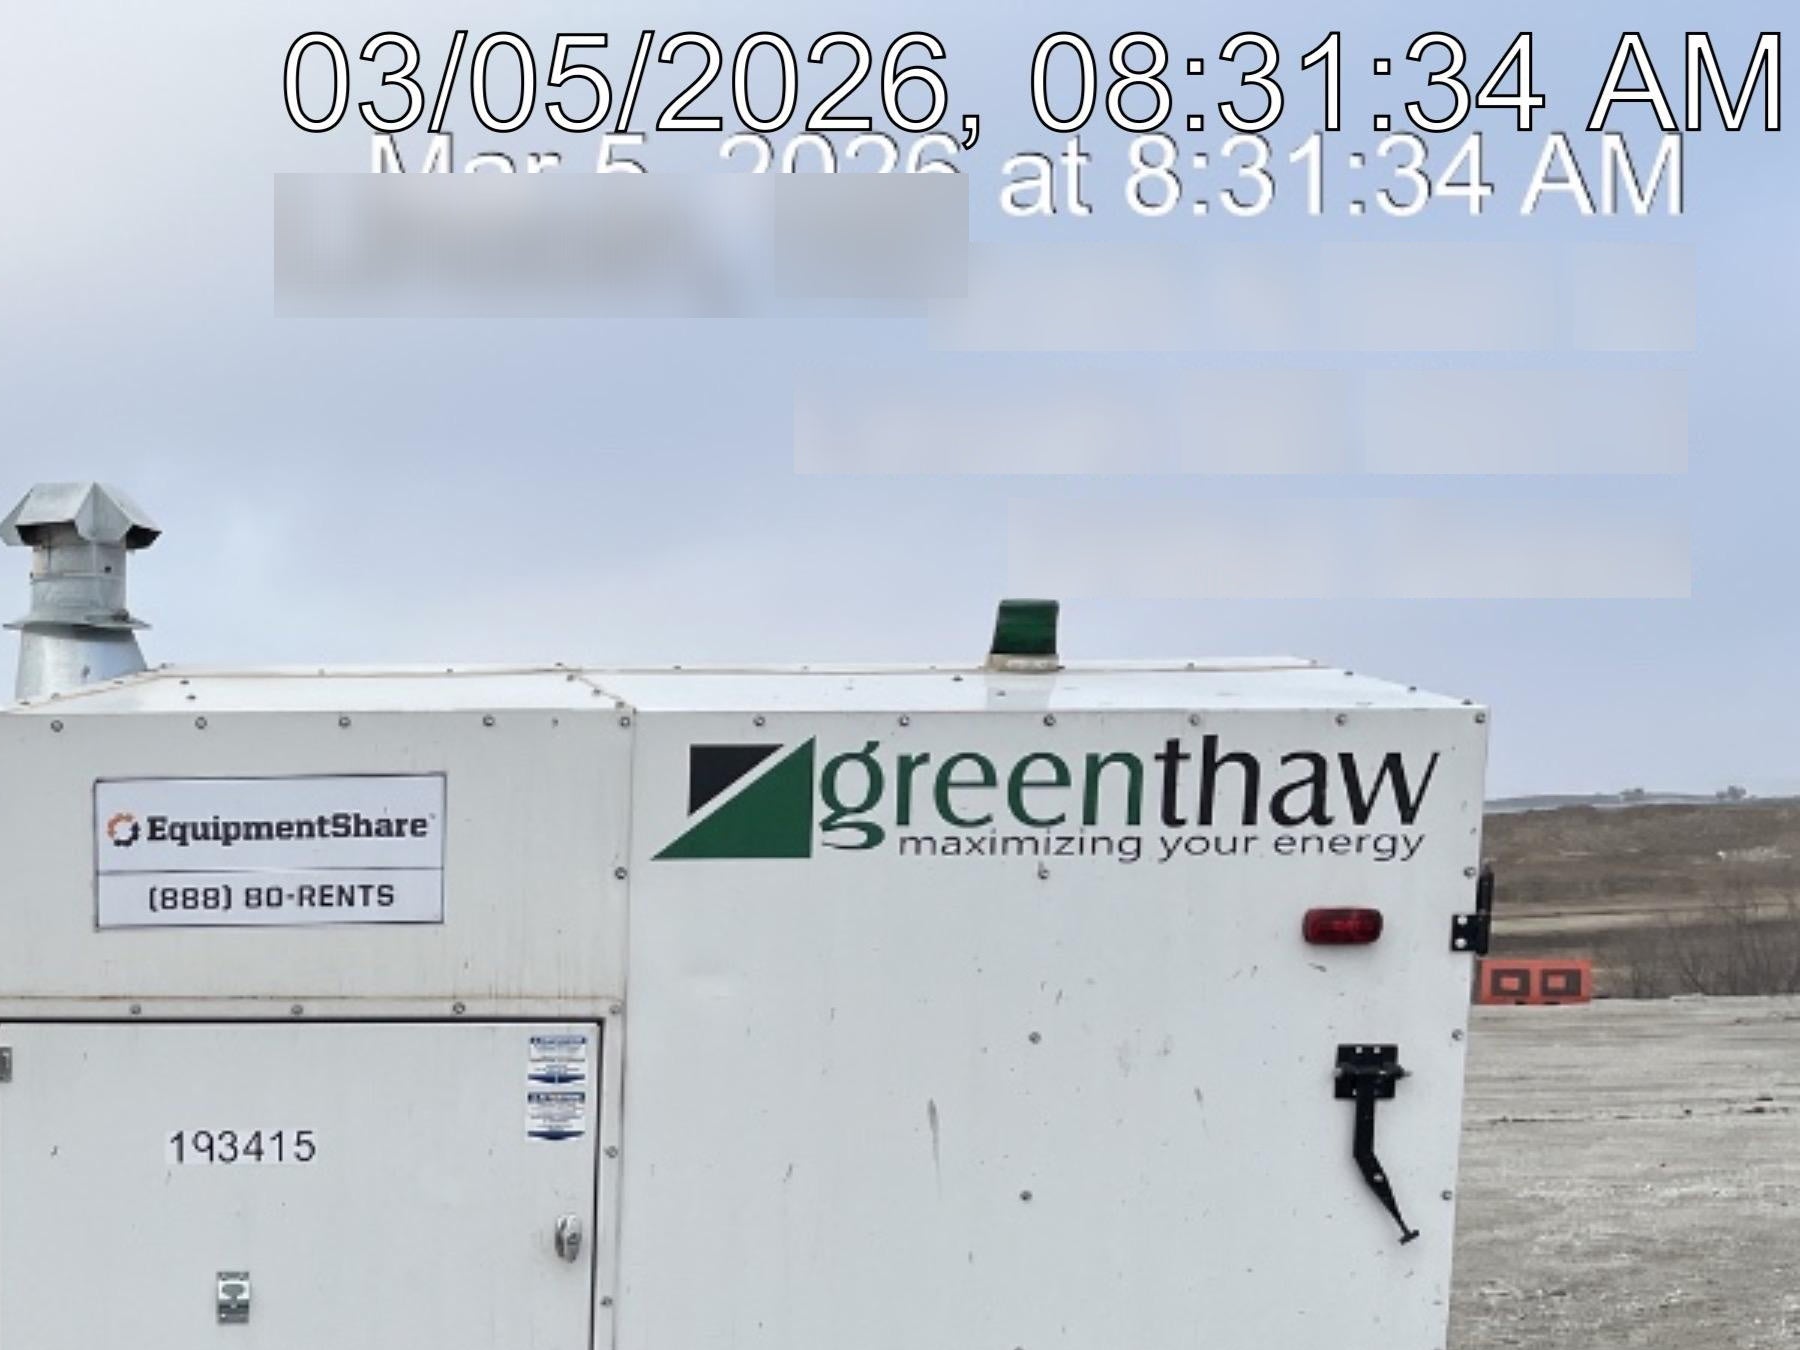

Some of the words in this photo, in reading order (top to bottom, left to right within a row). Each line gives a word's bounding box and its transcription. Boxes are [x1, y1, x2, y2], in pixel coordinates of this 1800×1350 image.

[818, 733, 1441, 850] greenthaw
[146, 813, 428, 847] EquipmentShare
[899, 827, 1143, 863] maximizing
[1158, 832, 1260, 862] your
[1273, 832, 1426, 862] energy
[148, 884, 232, 912] (888)
[244, 883, 395, 908] 80-RENTS
[170, 1130, 316, 1163] 193415
